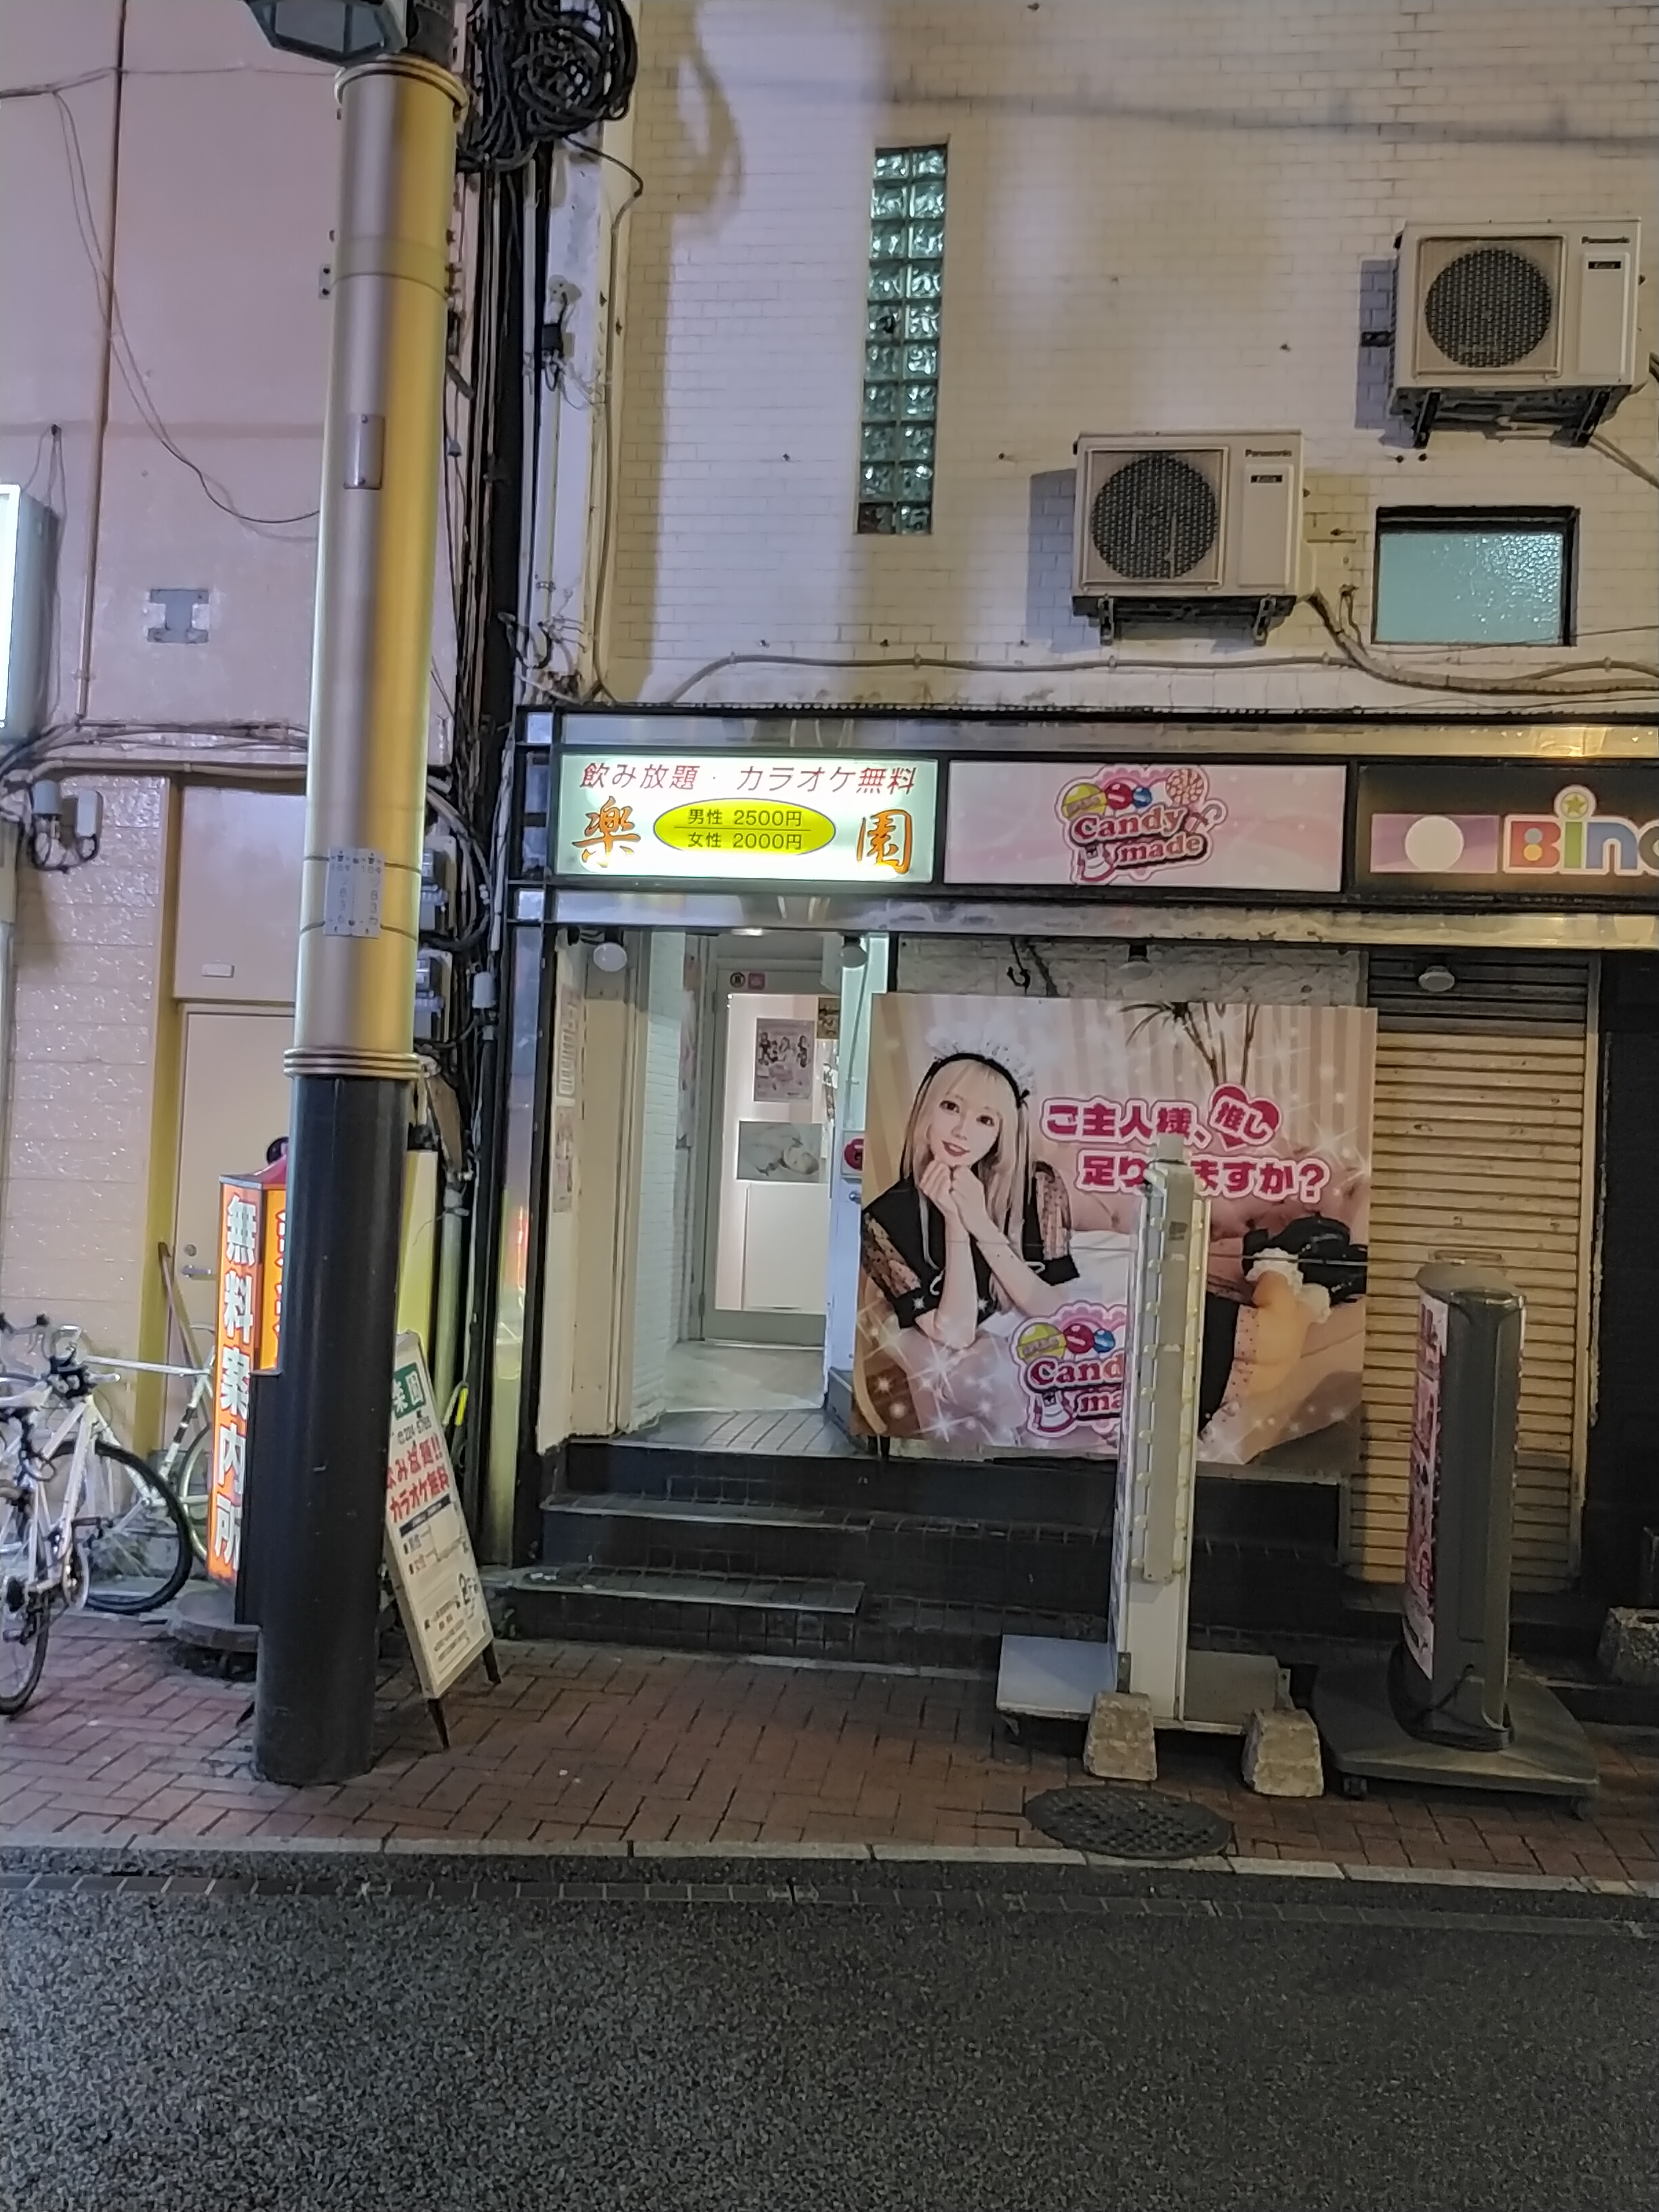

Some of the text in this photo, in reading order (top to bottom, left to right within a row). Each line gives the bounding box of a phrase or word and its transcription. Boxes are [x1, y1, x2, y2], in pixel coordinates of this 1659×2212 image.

[687, 808, 802, 827] 男性 2500円
[1073, 806, 1185, 840] Candy
[687, 832, 802, 851] 女性 2000円
[855, 808, 914, 874] 園
[1119, 835, 1202, 863] made
[1083, 1154, 1324, 1198] 足りますか?
[213, 1193, 257, 1572] 無料案内所
[1030, 1353, 1124, 1385] Cand
